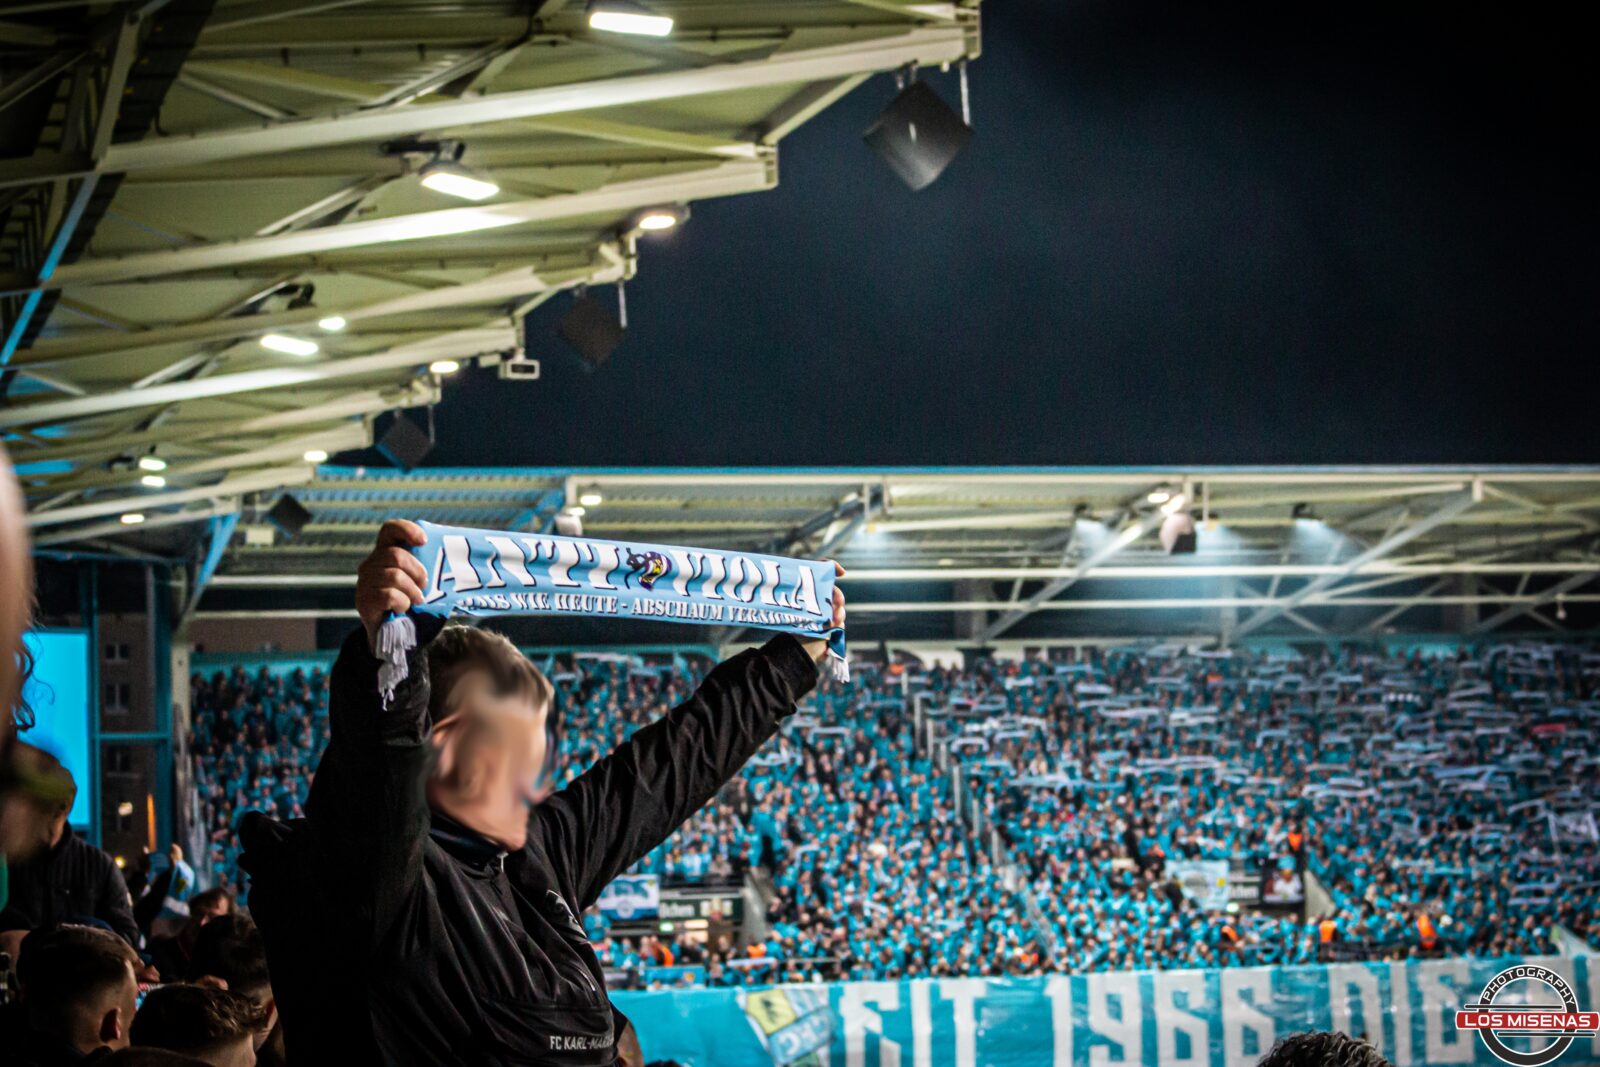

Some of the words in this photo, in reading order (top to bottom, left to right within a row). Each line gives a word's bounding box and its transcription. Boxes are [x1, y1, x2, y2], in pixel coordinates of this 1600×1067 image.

[424, 535, 618, 604] ANTI
[668, 549, 822, 616] VIOLA
[510, 592, 551, 611] WIE
[554, 593, 618, 614] HEUTE
[631, 597, 725, 621] ABSCHAUM
[549, 1035, 562, 1050] FC
[1044, 968, 1276, 1067] 1966
